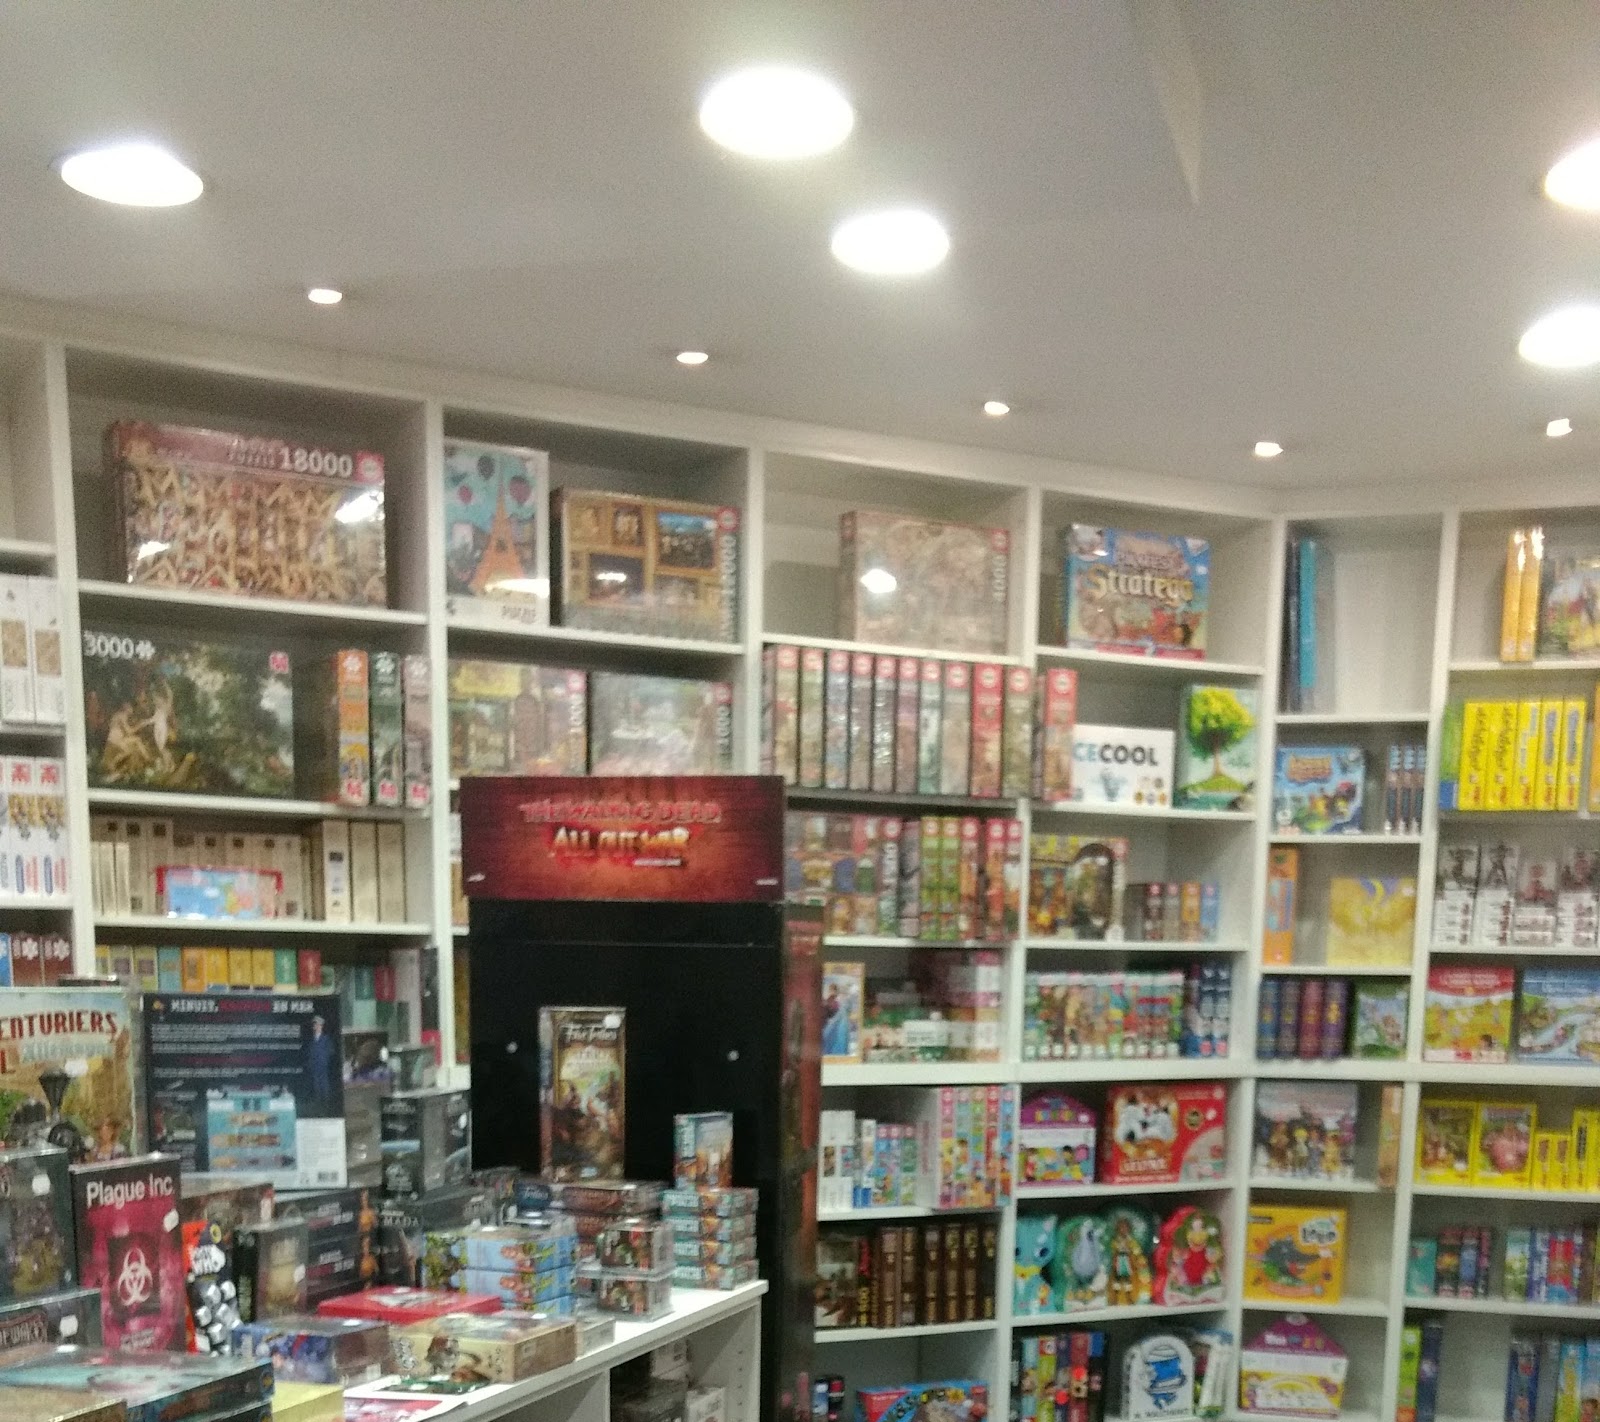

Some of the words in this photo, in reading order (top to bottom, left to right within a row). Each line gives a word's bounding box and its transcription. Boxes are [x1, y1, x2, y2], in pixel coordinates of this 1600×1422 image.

[279, 447, 353, 478] 18000
[1087, 563, 1193, 608] Stratego
[83, 630, 134, 659] 3000
[1073, 743, 1158, 766] CECOOL
[86, 1180, 145, 1211] Plague
